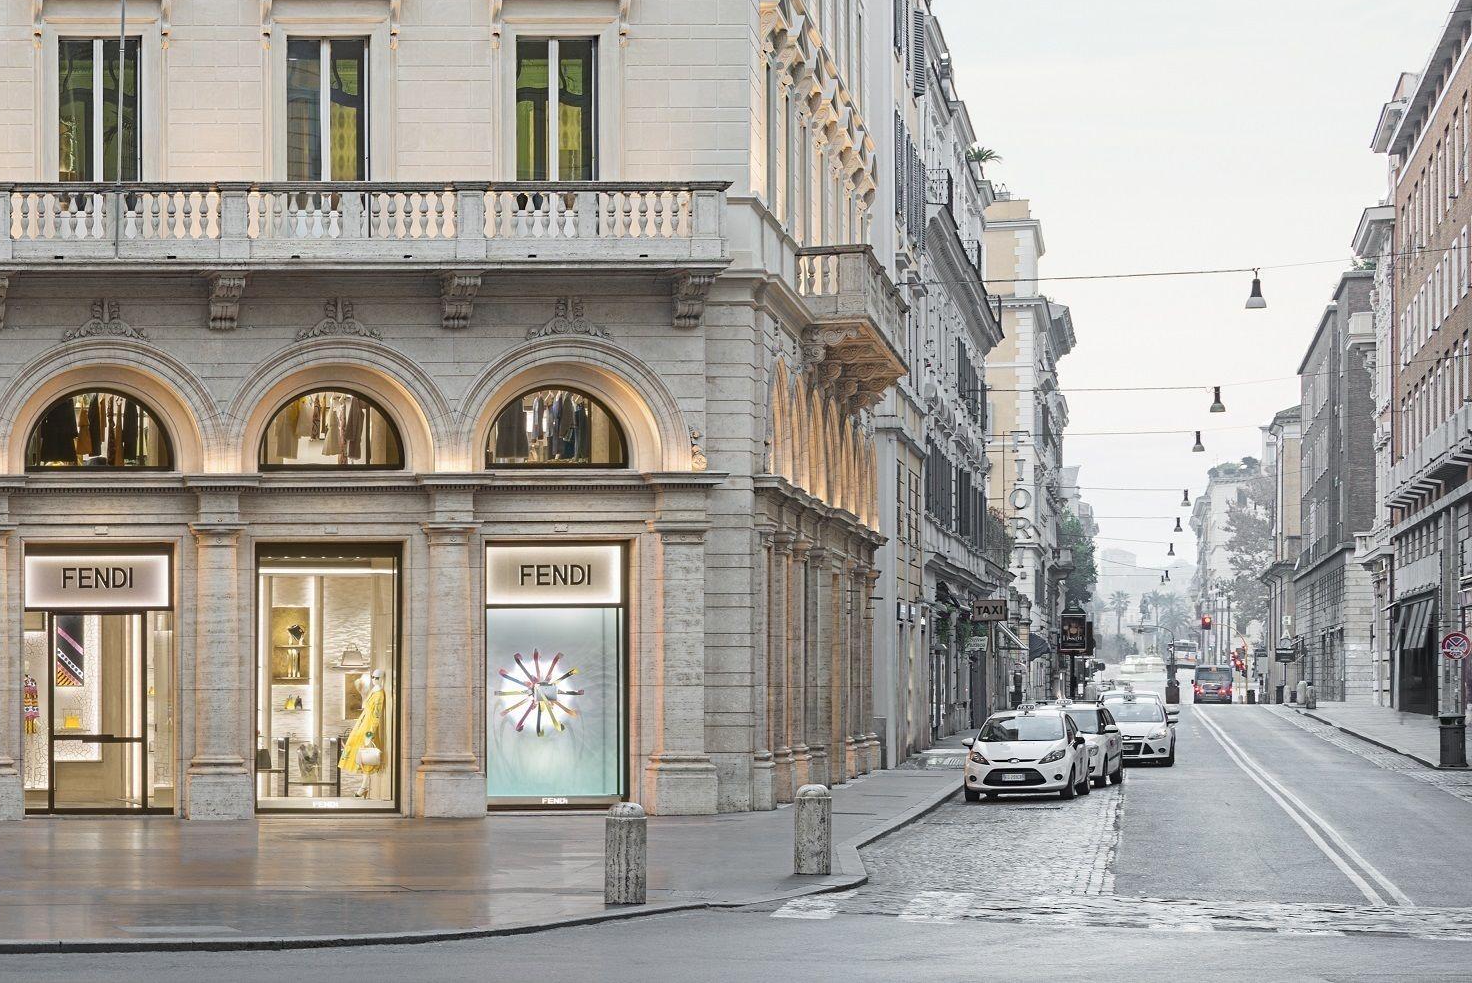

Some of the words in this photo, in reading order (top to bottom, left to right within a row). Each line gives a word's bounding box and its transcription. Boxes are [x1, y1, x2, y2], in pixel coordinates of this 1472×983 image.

[62, 567, 133, 588] FENDI
[519, 564, 591, 586] FENDI
[975, 605, 1003, 616] TAXI
[541, 797, 568, 805] FENDI
